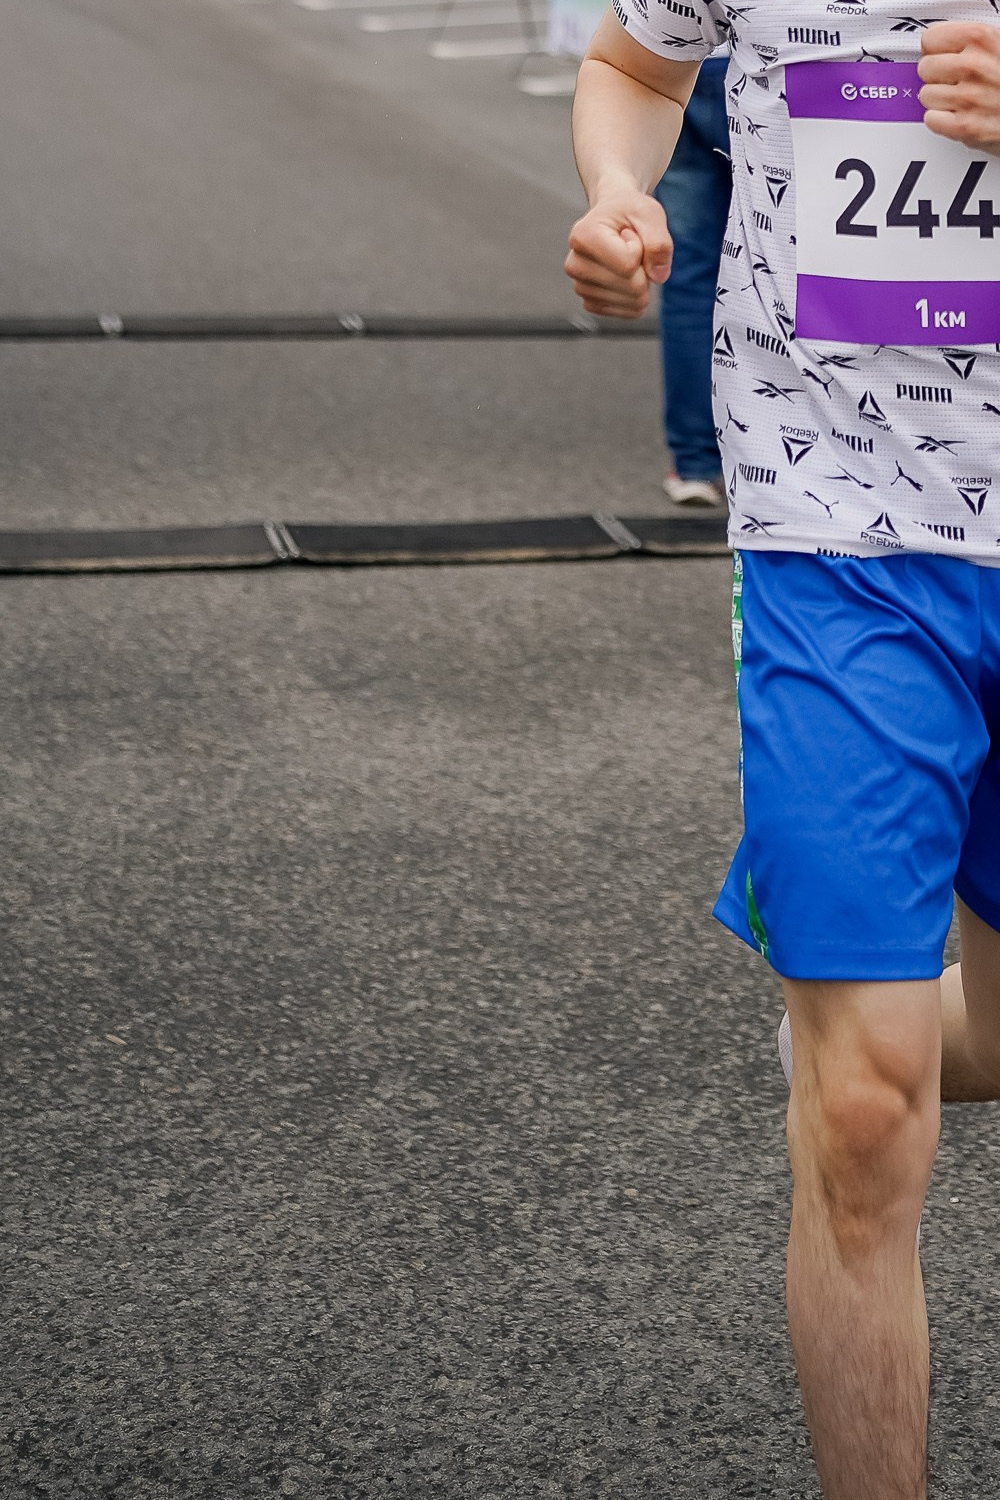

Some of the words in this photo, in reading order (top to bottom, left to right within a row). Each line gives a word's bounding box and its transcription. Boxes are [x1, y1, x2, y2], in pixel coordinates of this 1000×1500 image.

[826, 4, 869, 16] Reebok
[788, 27, 841, 46] PUMA
[859, 86, 898, 99] СБЕР
[896, 383, 952, 403] PUMA
[779, 424, 820, 441] Reebok
